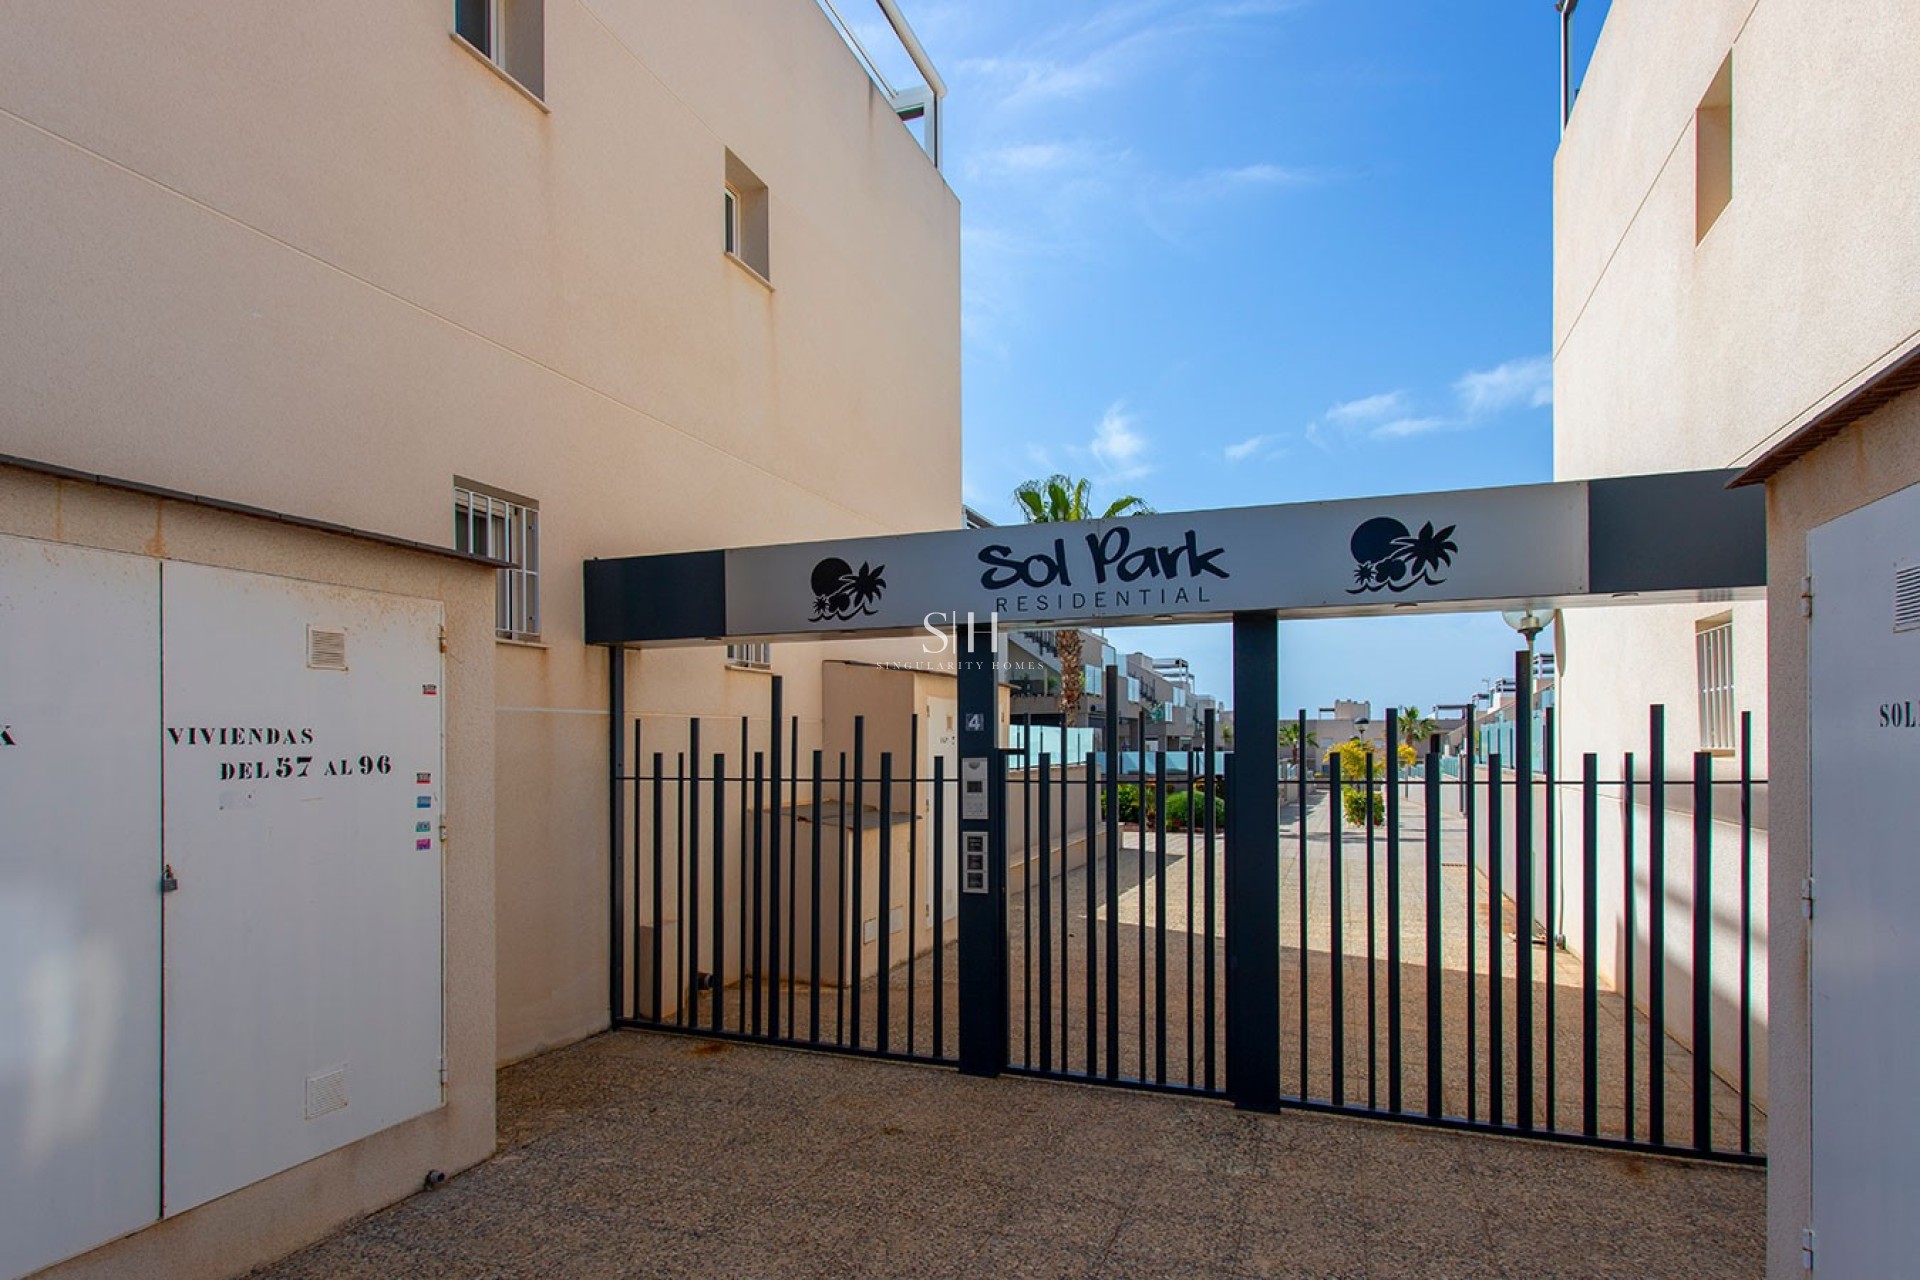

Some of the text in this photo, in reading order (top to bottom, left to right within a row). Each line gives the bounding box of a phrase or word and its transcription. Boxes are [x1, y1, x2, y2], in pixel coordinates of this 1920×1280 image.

[977, 526, 1230, 590] Sol Park
[996, 586, 1210, 613] RESIDENTIAL
[968, 714, 982, 731] 4
[167, 727, 314, 746] VIVIENDAS
[220, 755, 392, 780] DEL 57 AL 96
